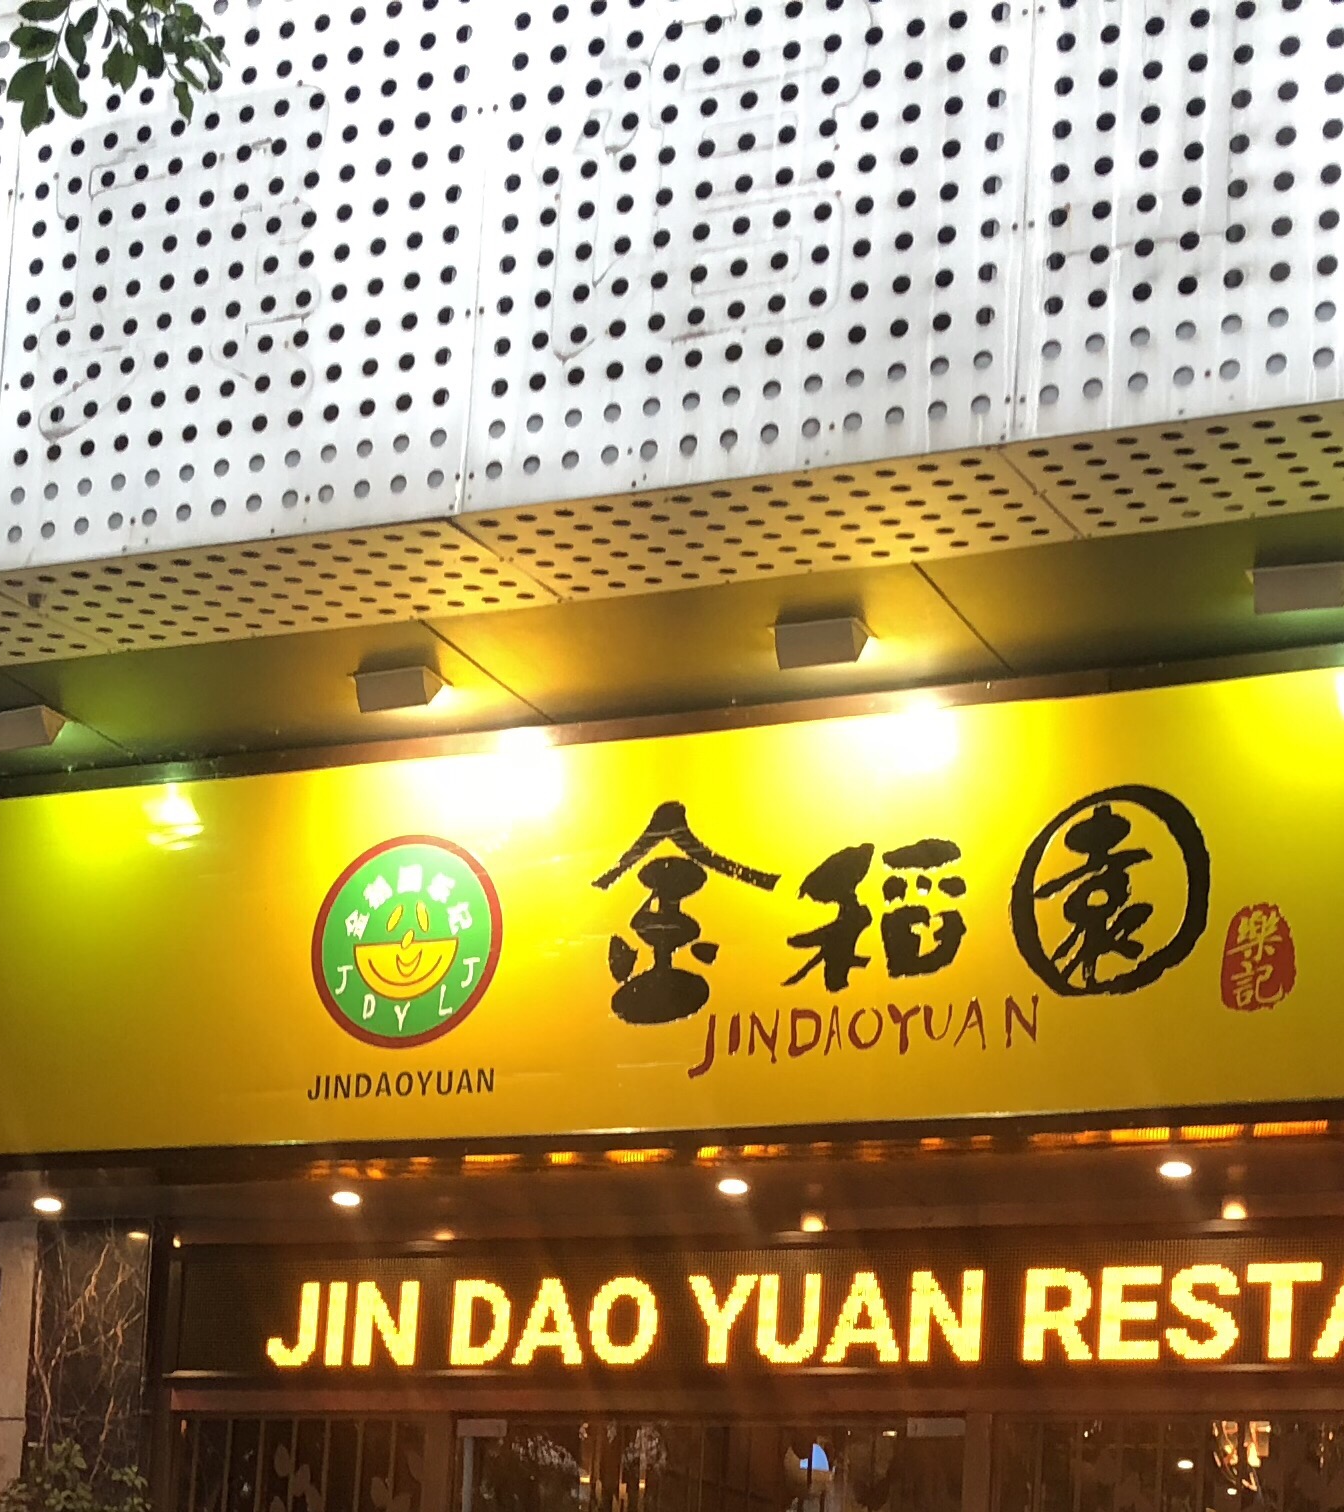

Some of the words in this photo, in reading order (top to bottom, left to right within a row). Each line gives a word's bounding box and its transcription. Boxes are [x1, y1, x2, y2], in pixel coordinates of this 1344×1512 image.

[687, 994, 1041, 1079] JINDAOYUAN
[307, 1067, 495, 1101] JINDAOYUAN
[266, 1280, 421, 1367] JIN
[449, 1276, 660, 1367] DAO
[688, 1268, 985, 1364] YUAN
